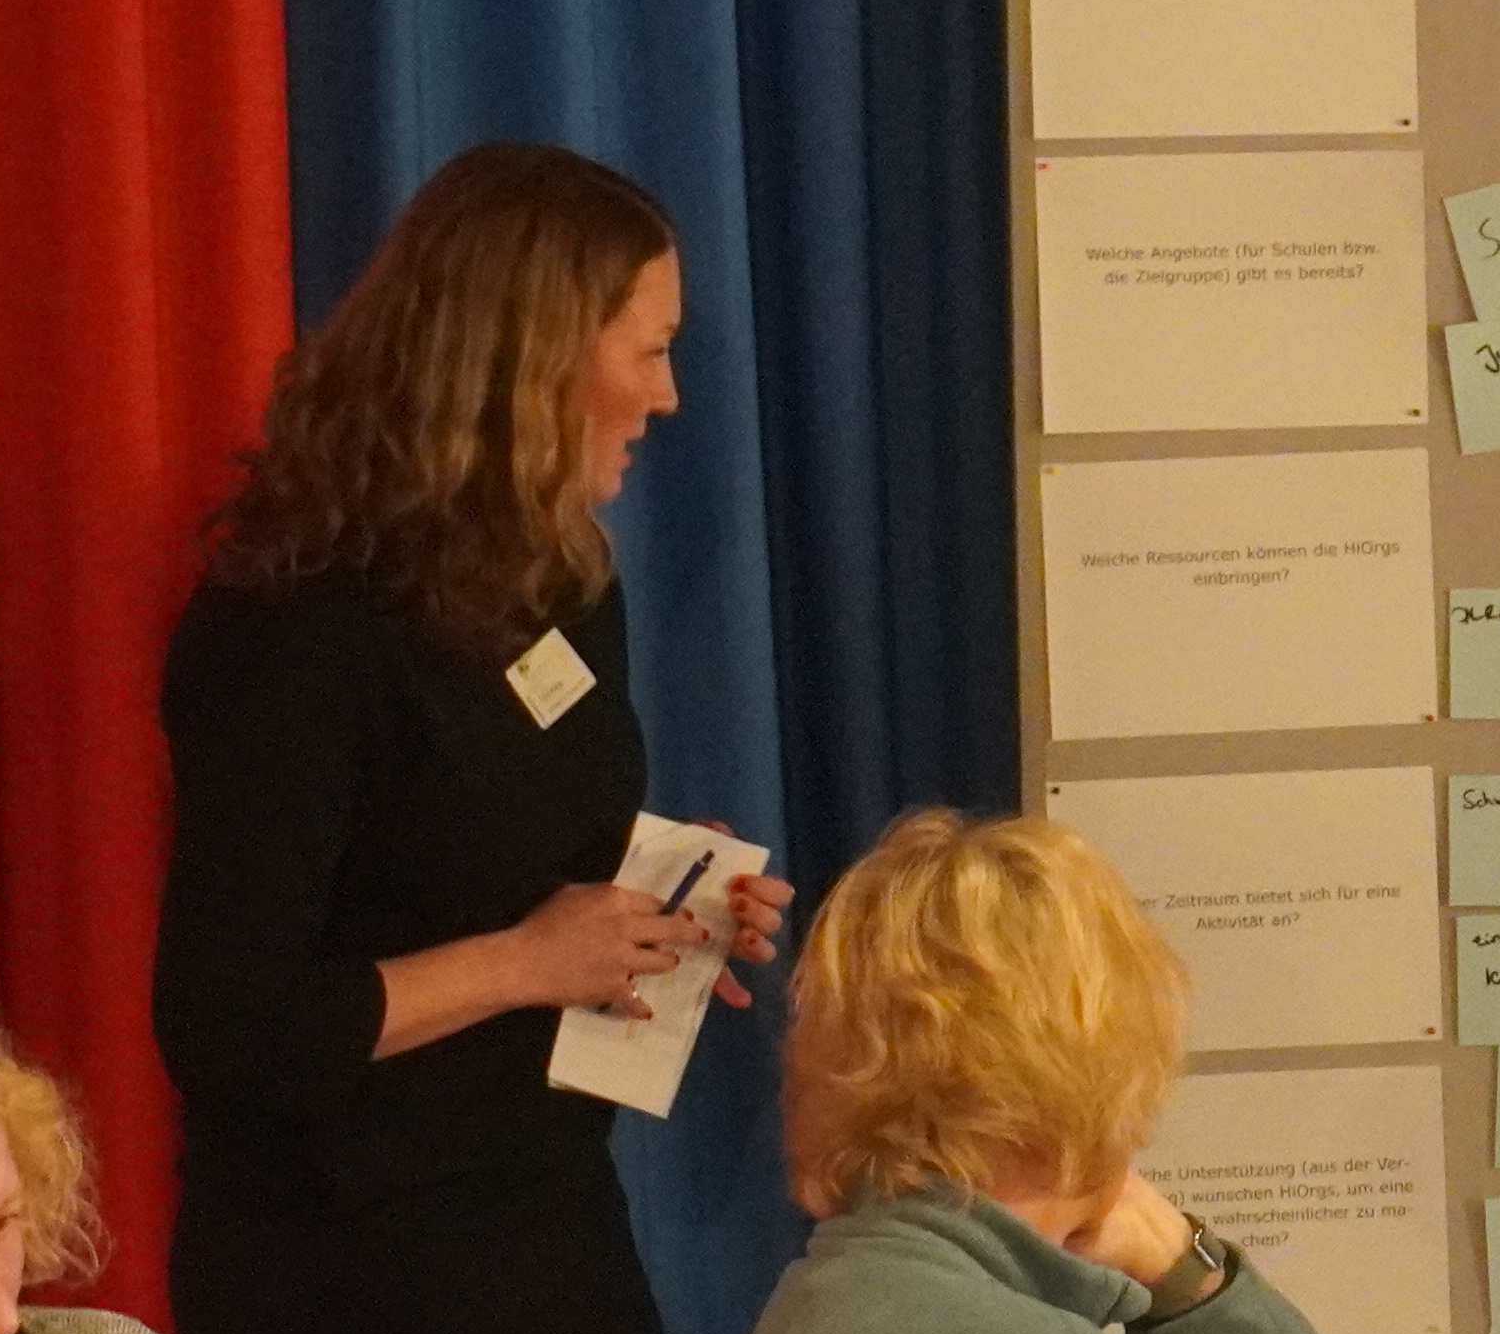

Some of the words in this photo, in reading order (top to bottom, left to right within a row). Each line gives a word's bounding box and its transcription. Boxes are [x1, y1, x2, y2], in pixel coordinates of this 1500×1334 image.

[1085, 246, 1145, 261] Welche
[1151, 245, 1229, 264] Angebote
[1271, 240, 1337, 256] Schulen
[1104, 271, 1127, 285] die
[1135, 268, 1230, 286] Zielgruppe)
[1236, 267, 1267, 285] gibt
[1274, 269, 1291, 281] es
[1298, 264, 1364, 280] bereits?
[1081, 551, 1140, 567] Welche
[1145, 548, 1241, 565] Ressourcen
[1246, 545, 1307, 561] können
[1312, 542, 1338, 557] die
[1343, 540, 1401, 558] HiOrgs
[1192, 568, 1290, 586] einbringen?
[1164, 893, 1240, 910] Zeitraum
[1245, 889, 1294, 906] bietet
[1299, 887, 1331, 903] sich
[1365, 884, 1401, 900] eine
[1195, 914, 1264, 930] Aktivität
[1271, 911, 1301, 927] an?
[1178, 1162, 1295, 1182] Unterstützung
[1301, 1159, 1338, 1176] (aus
[1343, 1158, 1370, 1173] der
[1376, 1157, 1411, 1172] Ver-
[1191, 1186, 1274, 1203] wünschen
[1346, 1183, 1374, 1197] um
[1379, 1180, 1414, 1195] eine
[1211, 1205, 1350, 1226] wahrscheinlicher
[1355, 1207, 1376, 1219] zu
[1240, 1232, 1290, 1248] chen?
